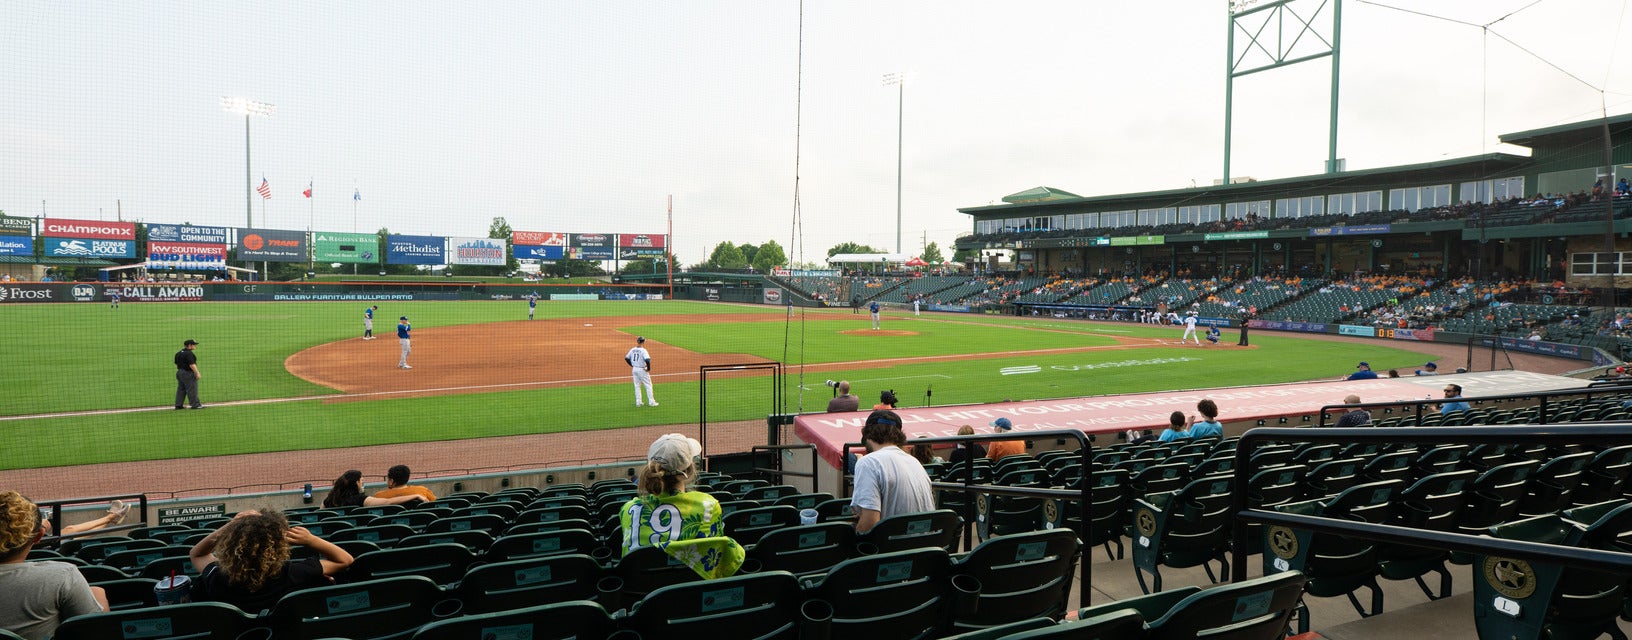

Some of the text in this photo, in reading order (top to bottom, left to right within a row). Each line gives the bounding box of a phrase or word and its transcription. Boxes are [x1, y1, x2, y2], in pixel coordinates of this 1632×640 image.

[201, 227, 211, 235] TO
[181, 234, 225, 242] COMMUNITY
[93, 246, 127, 254] POOLS
[171, 246, 222, 254] SOUTHWEST
[392, 244, 441, 254] Methodist
[458, 248, 502, 259] HOUSTON
[150, 253, 223, 262] BUD LIGHT
[10, 288, 52, 299] Frost
[123, 287, 155, 298] CALL
[158, 287, 203, 297] AMARO
[244, 285, 257, 293] GF
[933, 408, 996, 421] HIT
[993, 402, 1090, 416] YOUR
[1087, 395, 1205, 410] PROJECT
[182, 506, 218, 514] AWARE
[628, 502, 684, 551] 19
[1277, 560, 1285, 570] K
[1502, 600, 1511, 612] L
